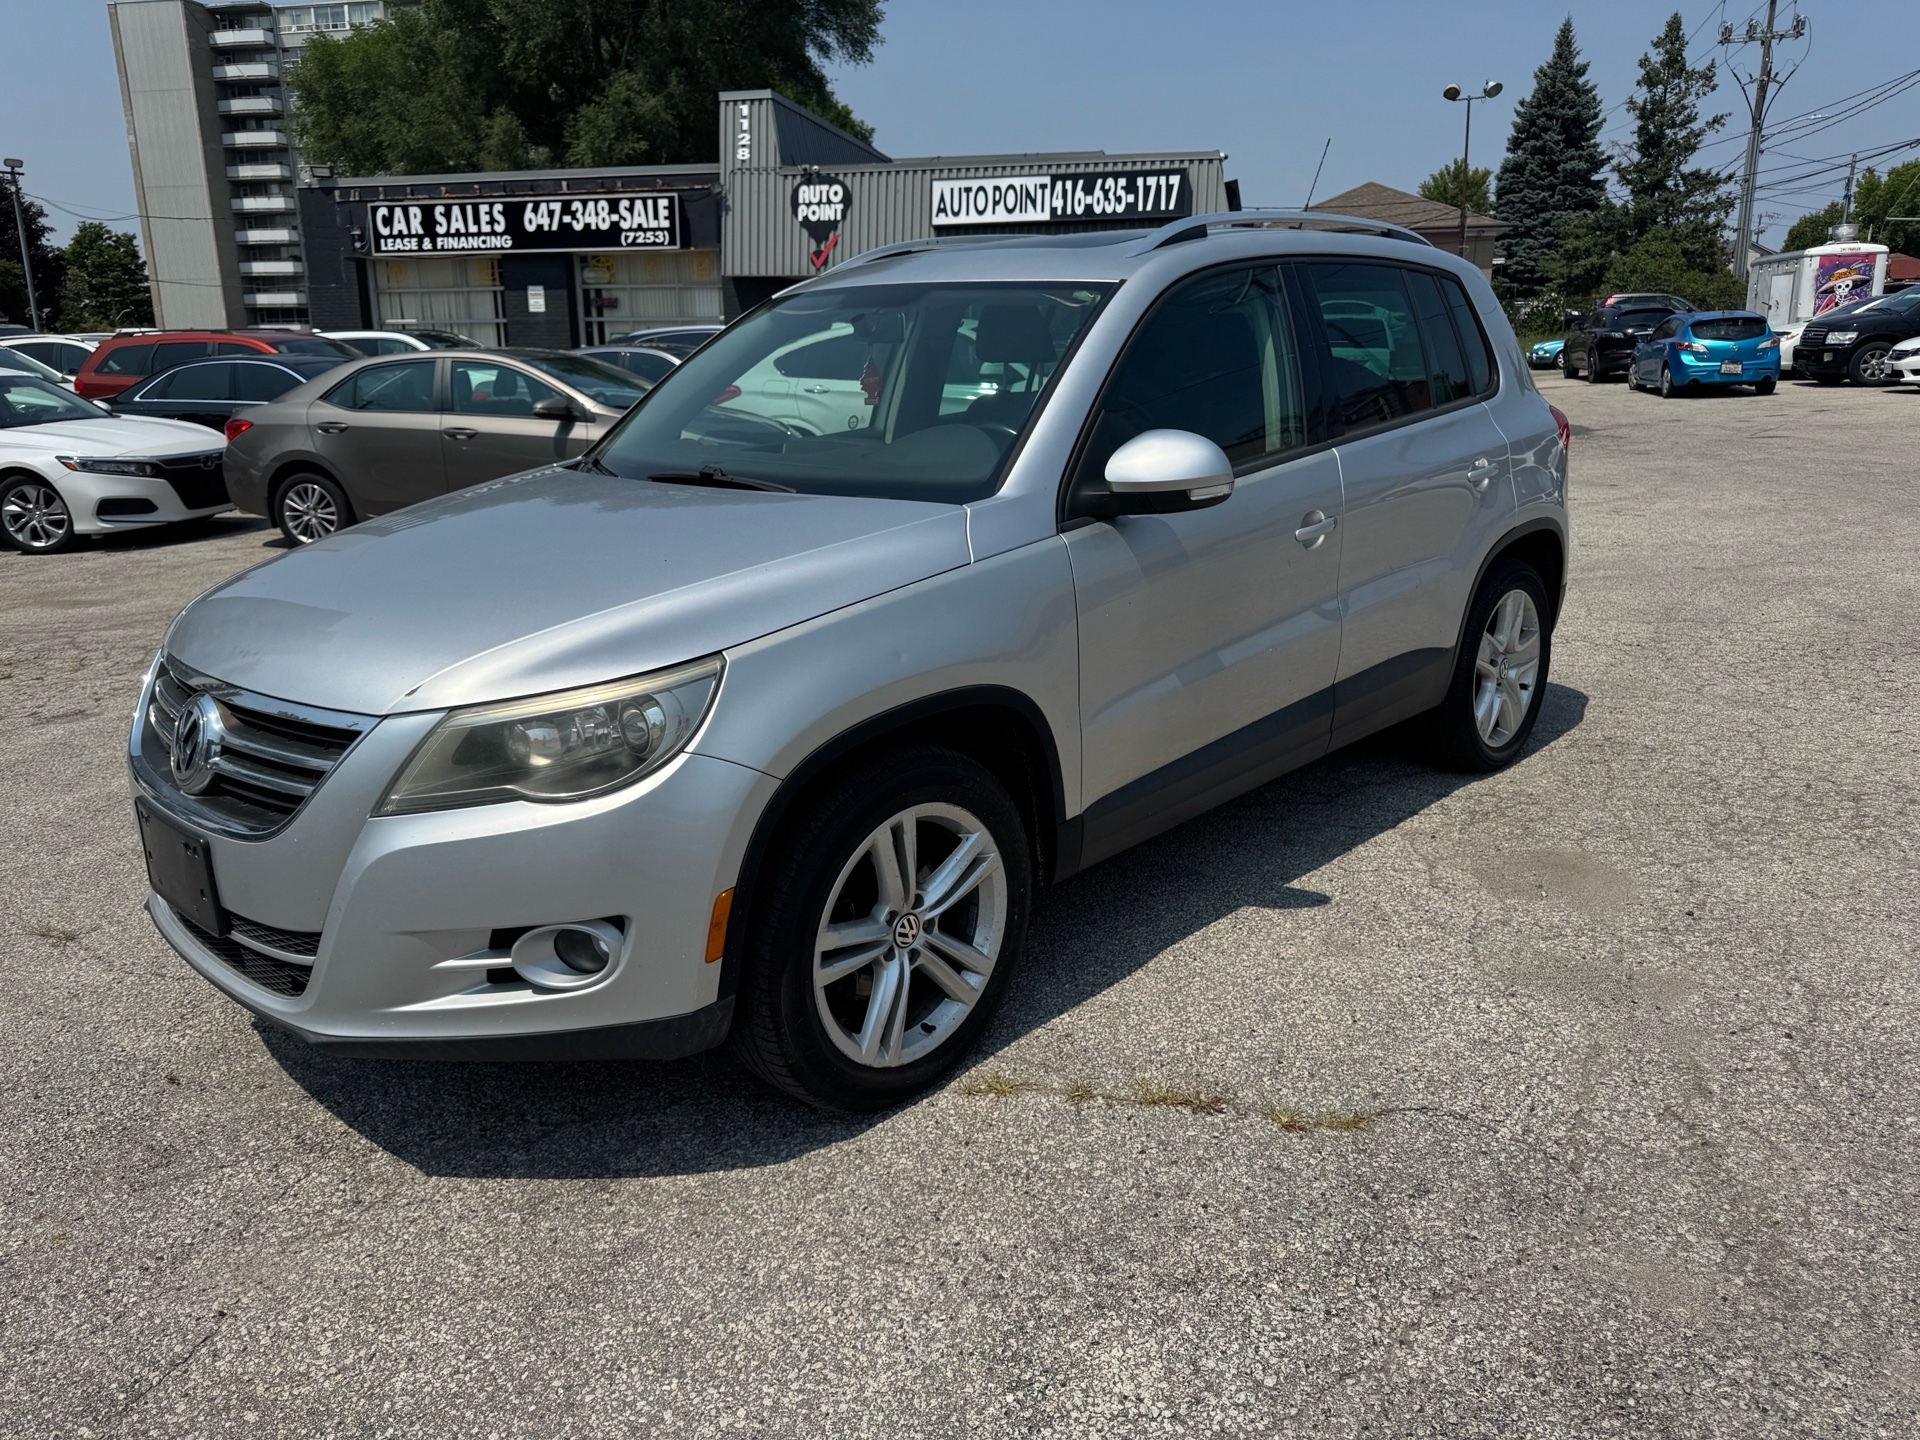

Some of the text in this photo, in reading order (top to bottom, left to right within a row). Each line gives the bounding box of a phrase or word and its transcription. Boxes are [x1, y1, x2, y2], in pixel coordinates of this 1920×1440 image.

[736, 104, 751, 160] 1128
[798, 184, 844, 204] AUTO
[935, 175, 1181, 218] AUTO POINT 416-635-1717
[376, 198, 671, 236] CAR SALES 647-348-SALE
[797, 203, 844, 222] POINT
[380, 235, 513, 251] LEASE & FINANCING
[620, 231, 670, 246] (7253)
